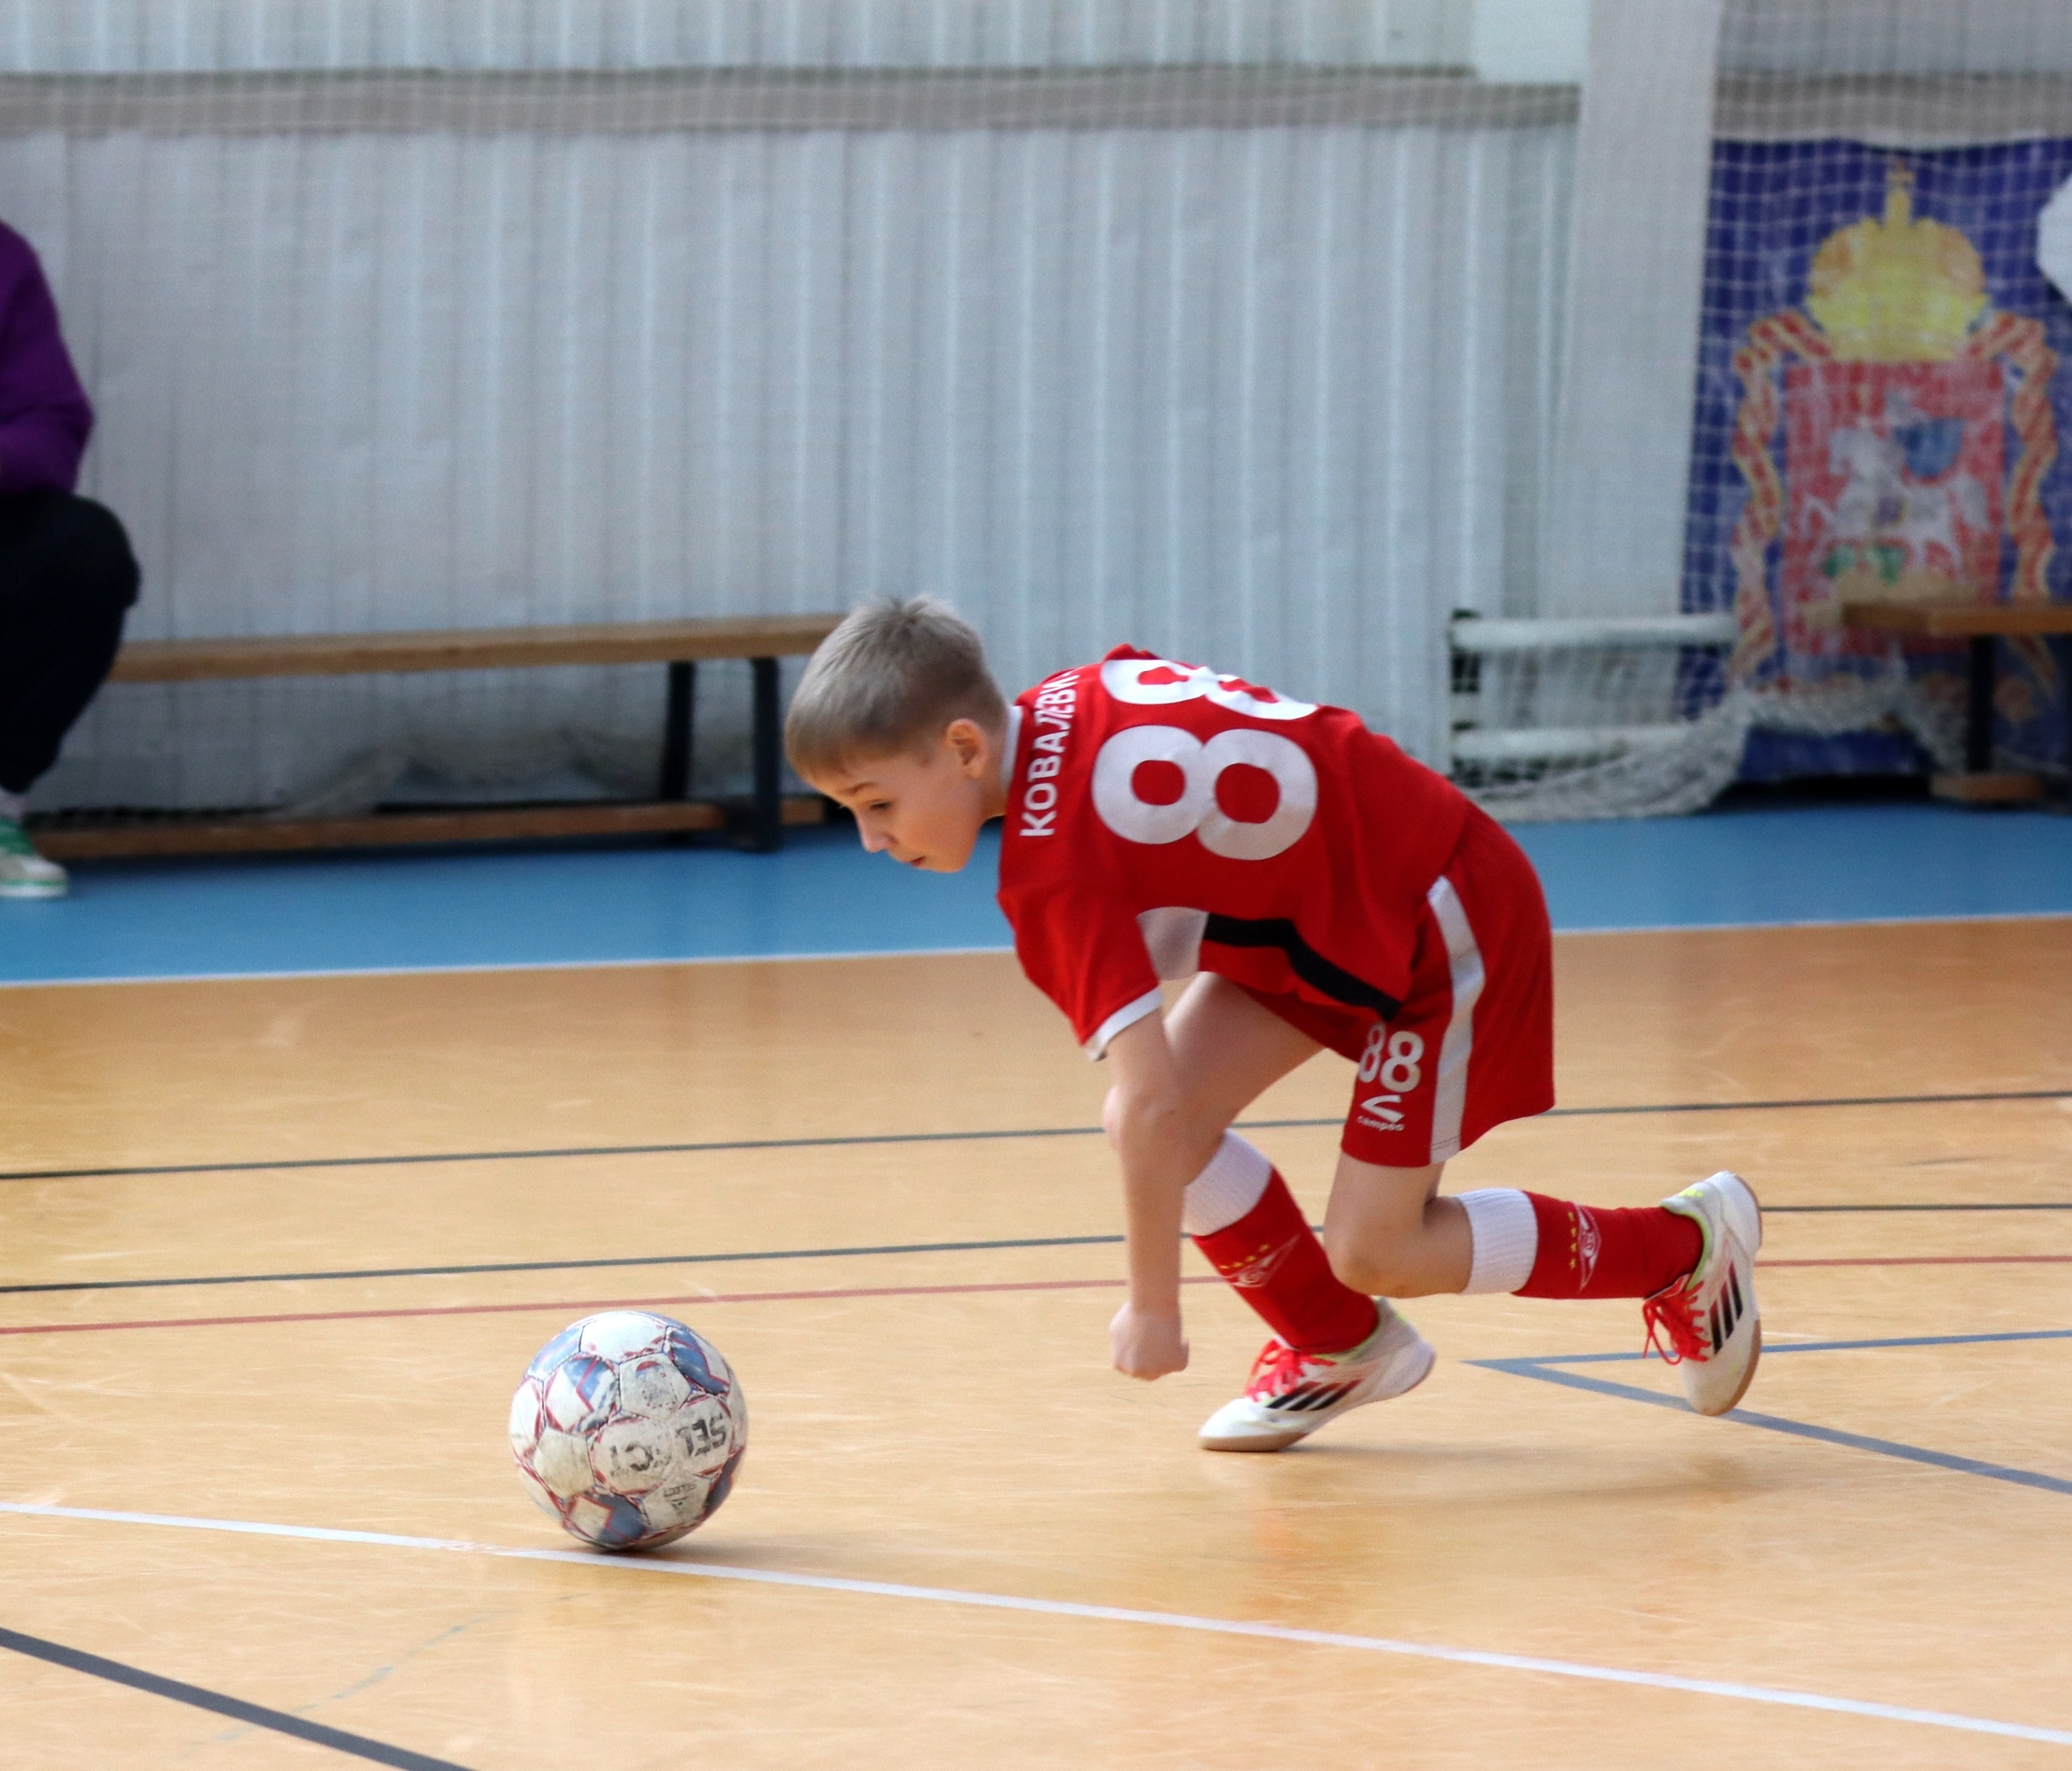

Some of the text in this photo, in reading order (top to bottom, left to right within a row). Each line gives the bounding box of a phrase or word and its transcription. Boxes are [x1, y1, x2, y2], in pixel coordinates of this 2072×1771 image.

[1020, 669, 1081, 837] КОВАЛЕВИ
[1092, 658, 1319, 860] 88
[1358, 1021, 1424, 1093] 88
